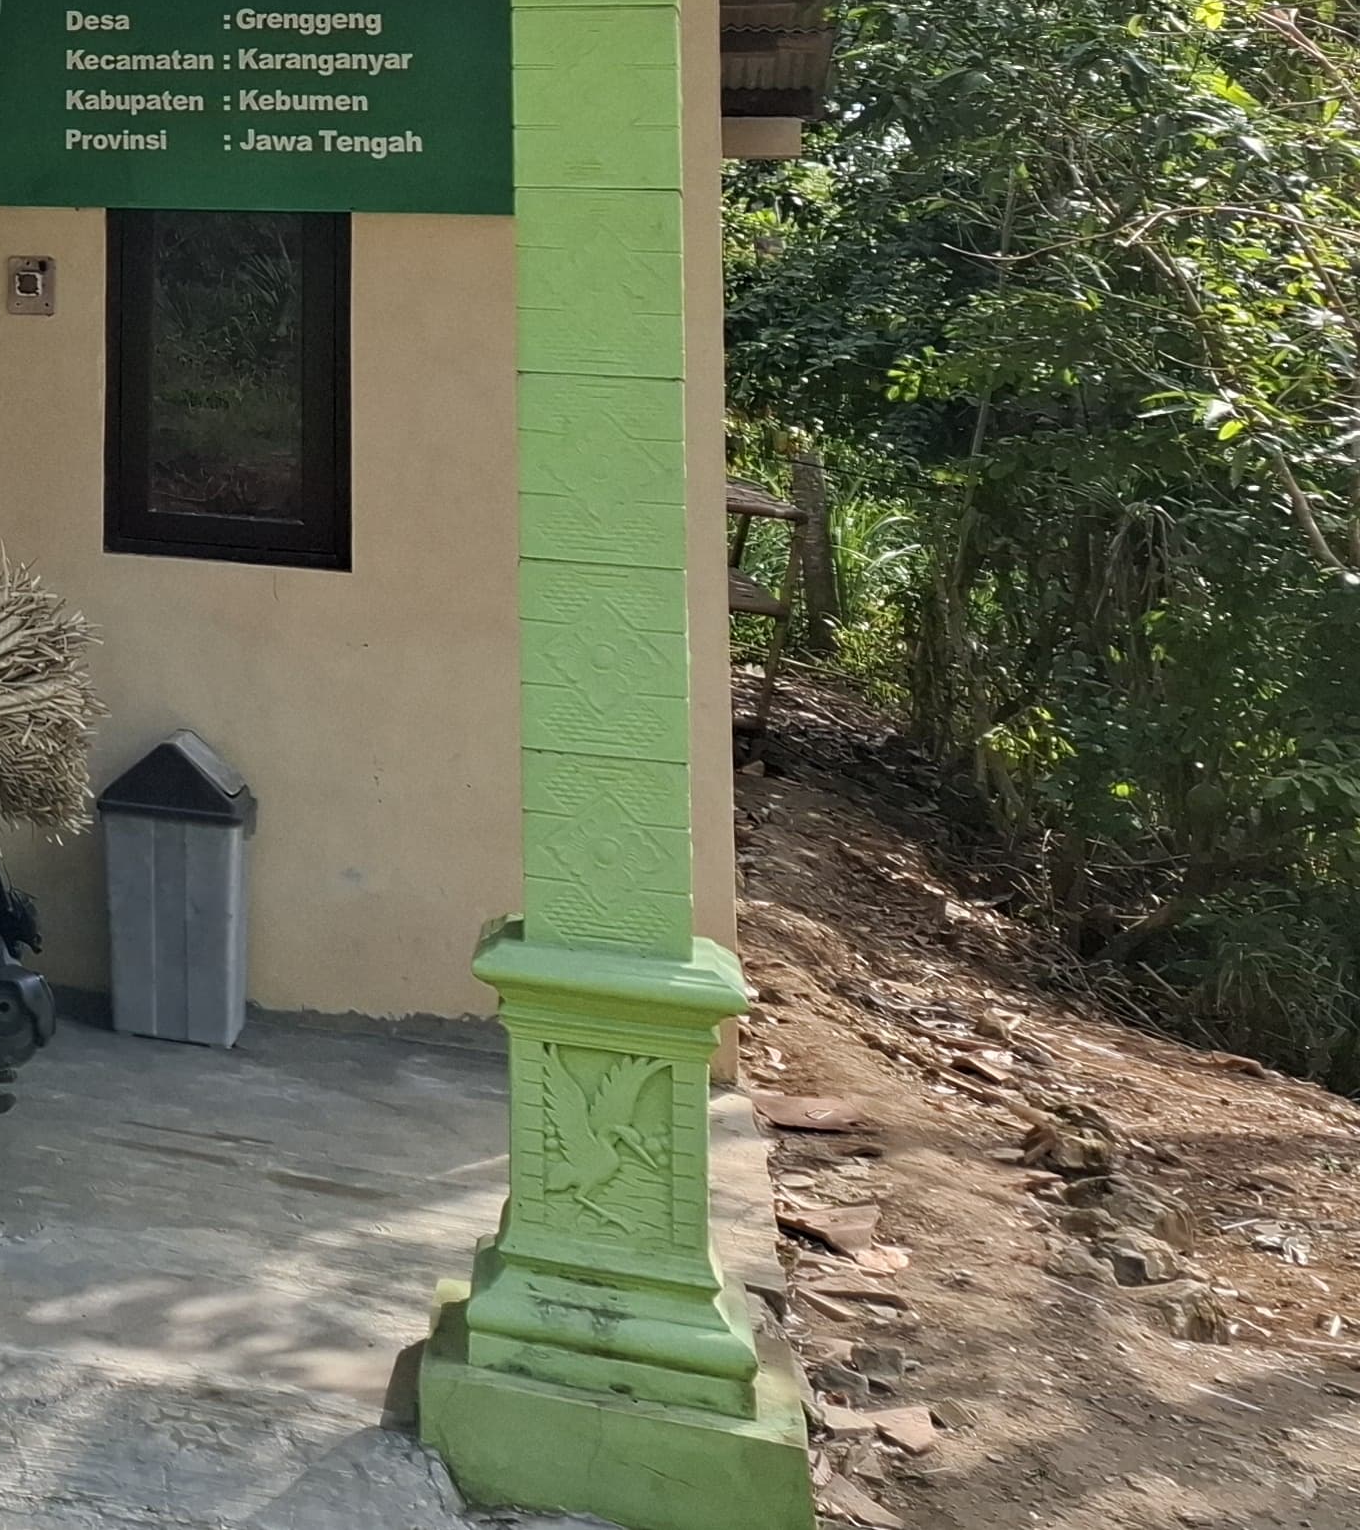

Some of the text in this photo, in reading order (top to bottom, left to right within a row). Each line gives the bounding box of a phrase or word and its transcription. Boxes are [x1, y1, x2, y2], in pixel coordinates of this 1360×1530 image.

[65, 10, 131, 32] Desa
[235, 8, 382, 35] Grenggeng
[65, 49, 215, 72] Kecamatan
[237, 48, 413, 75] Karanganyar
[65, 90, 205, 116] Kabupaten
[238, 90, 369, 113] Kebumen
[65, 129, 168, 152] Provinsi
[238, 129, 314, 153] Jawa
[318, 131, 424, 159] Tengah
